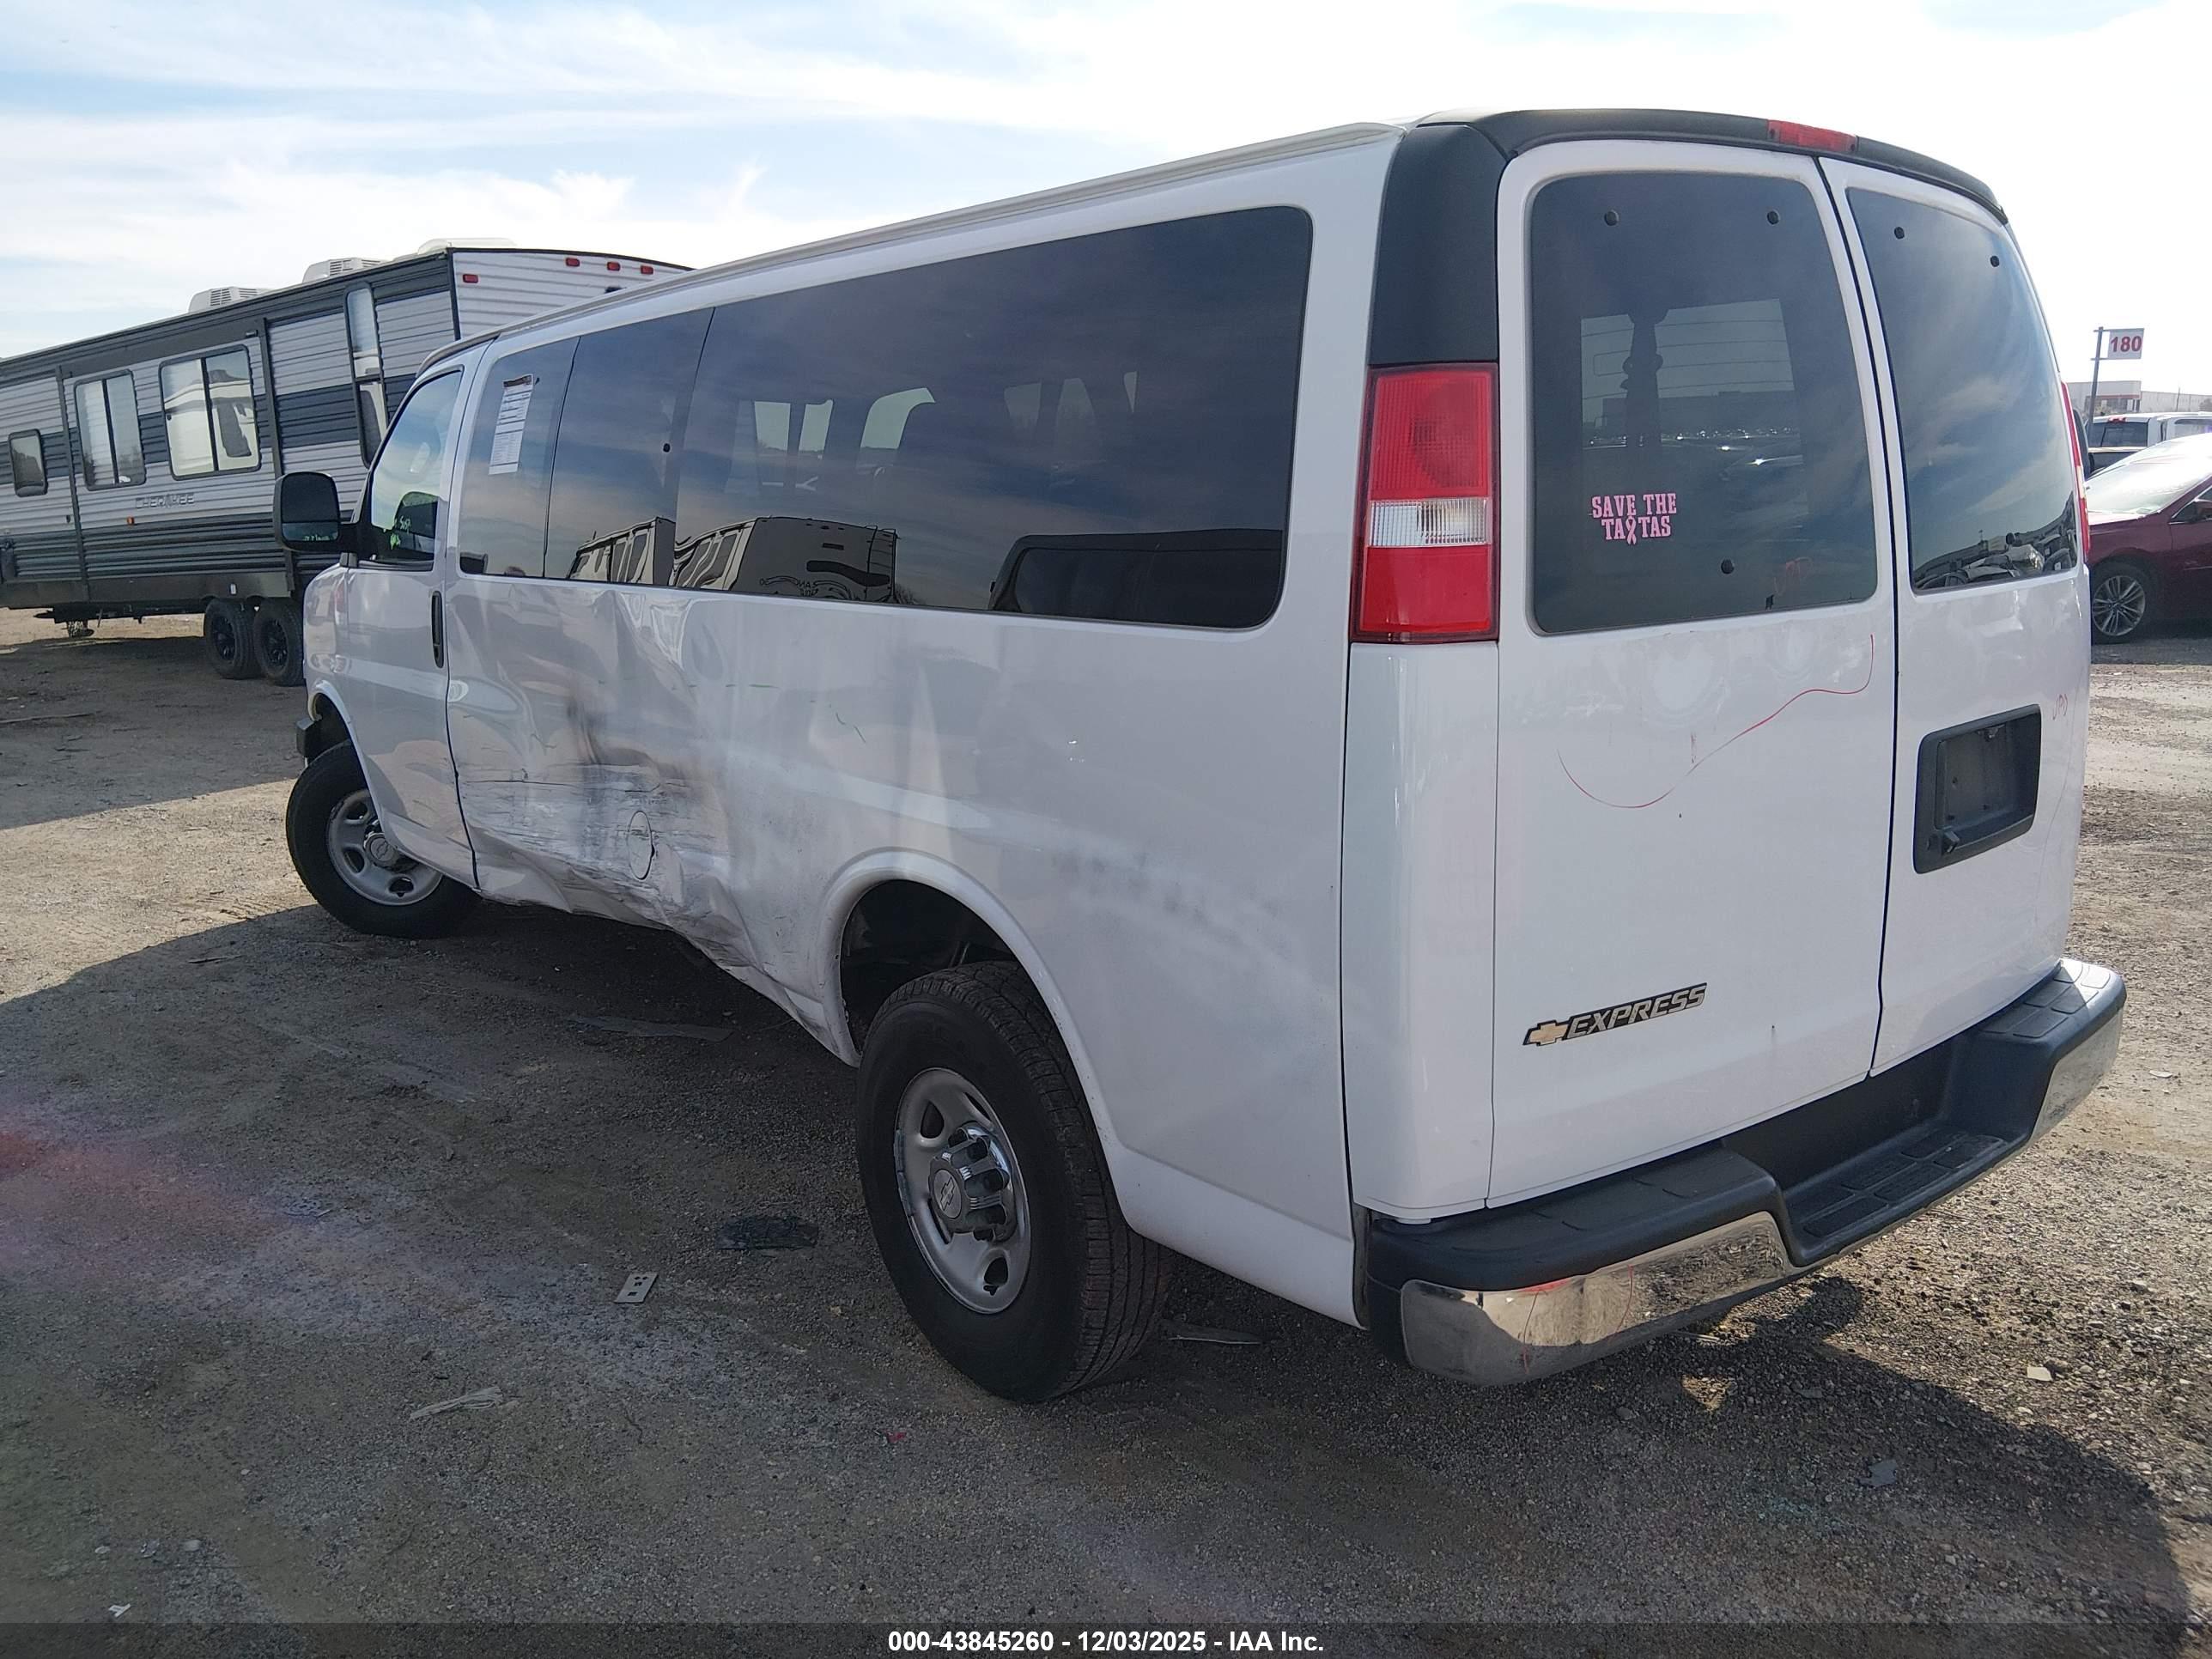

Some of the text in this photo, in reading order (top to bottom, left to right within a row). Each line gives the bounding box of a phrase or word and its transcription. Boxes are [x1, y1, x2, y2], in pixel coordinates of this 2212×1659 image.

[2111, 336, 2142, 353] 180
[1591, 493, 1677, 519] SAVE THE
[1566, 985, 1707, 1039] EXPRESS
